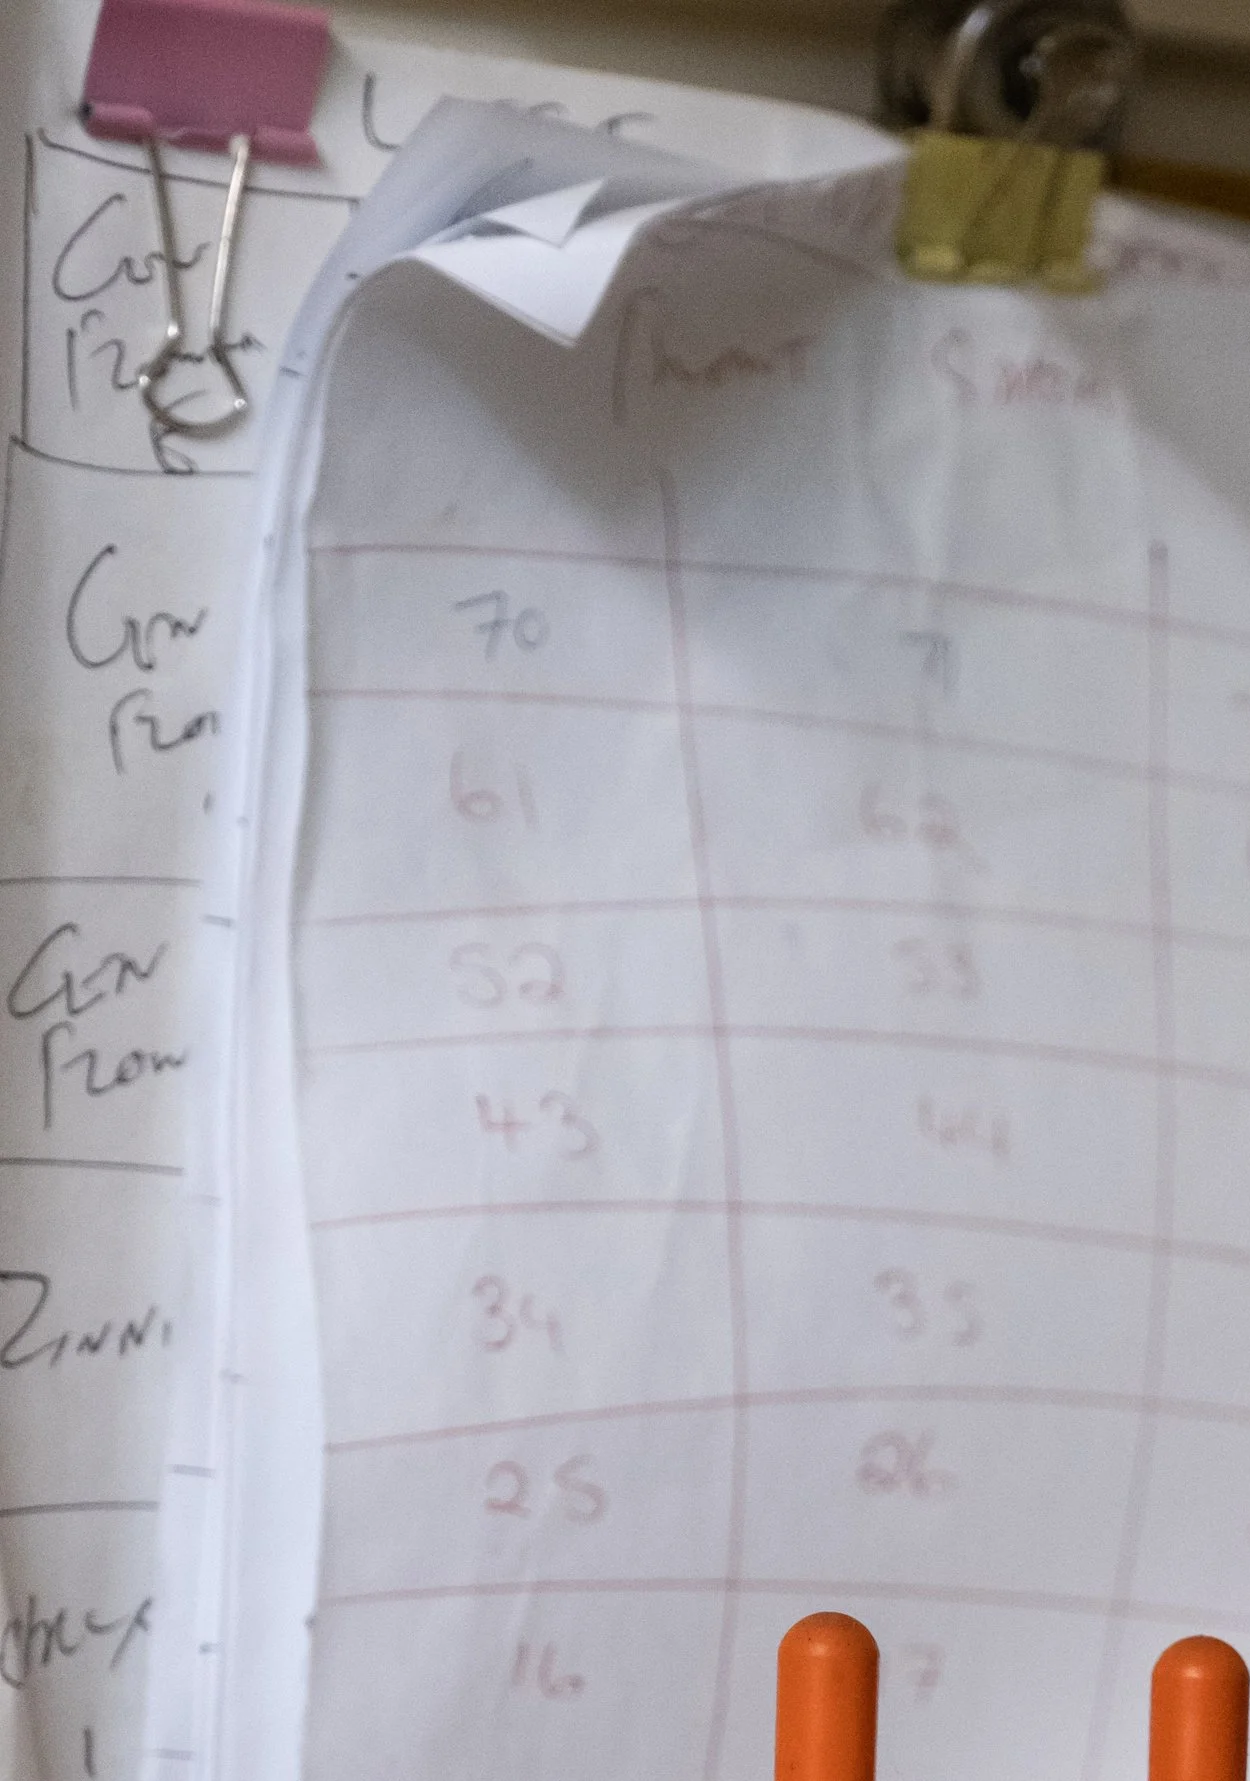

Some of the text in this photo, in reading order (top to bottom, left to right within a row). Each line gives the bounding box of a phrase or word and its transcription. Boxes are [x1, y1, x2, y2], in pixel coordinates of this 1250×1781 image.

[455, 592, 548, 660] 70
[447, 748, 536, 830] 61
[474, 1092, 601, 1162] 43
[469, 1275, 564, 1354] 34
[484, 1455, 608, 1525] 25
